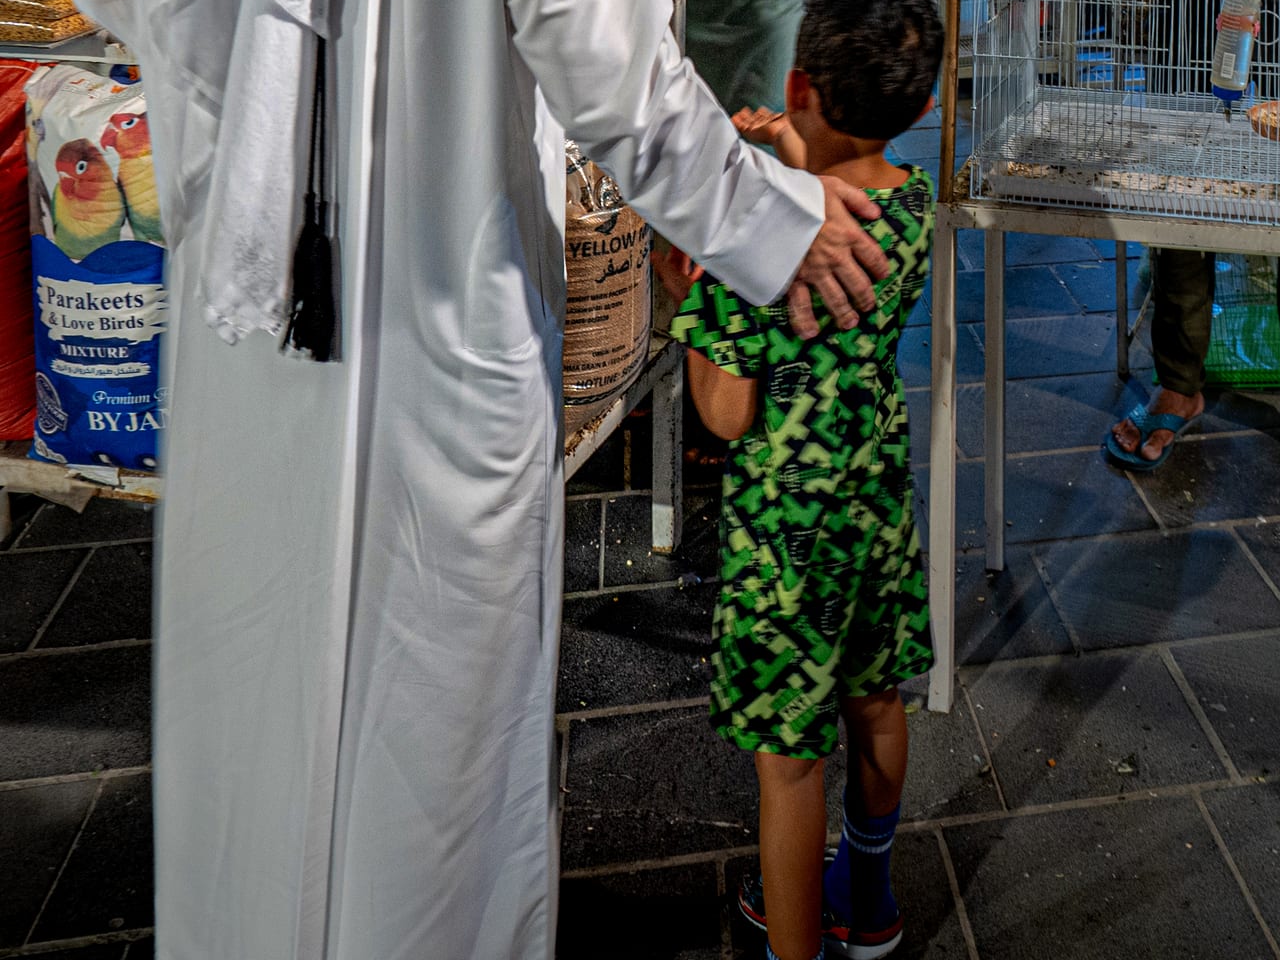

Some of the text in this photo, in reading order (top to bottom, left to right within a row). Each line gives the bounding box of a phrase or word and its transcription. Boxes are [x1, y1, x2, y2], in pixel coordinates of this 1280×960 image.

[570, 230, 637, 259] YELLOW
[46, 286, 144, 310] Parakeets
[48, 311, 144, 331] & Love Birds
[60, 343, 129, 359] MIXTURE
[92, 390, 151, 405] Premium
[87, 411, 122, 431] BY
